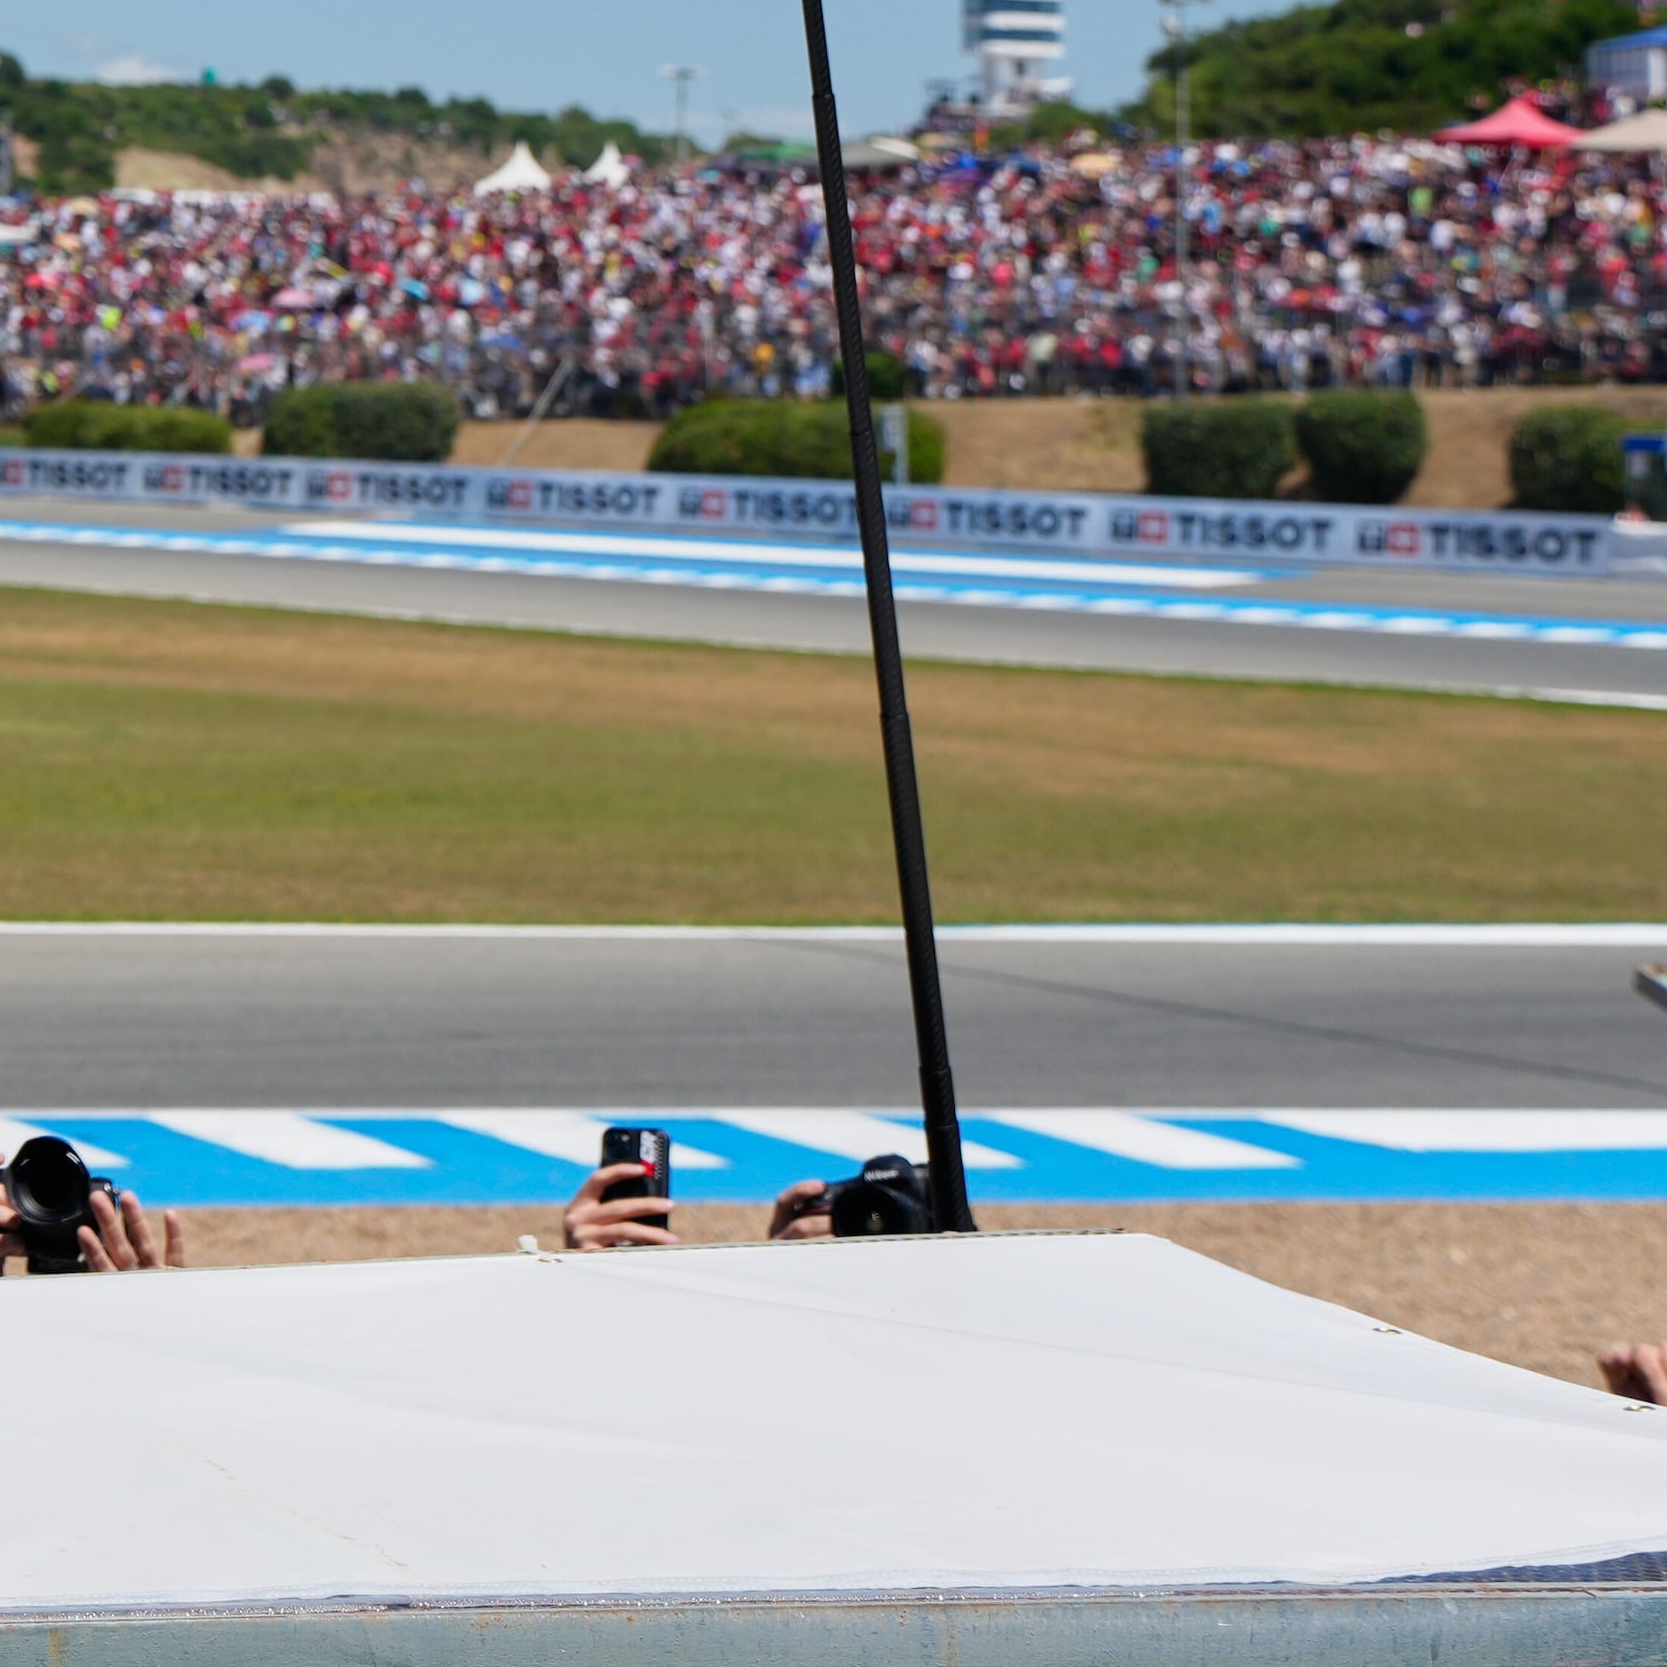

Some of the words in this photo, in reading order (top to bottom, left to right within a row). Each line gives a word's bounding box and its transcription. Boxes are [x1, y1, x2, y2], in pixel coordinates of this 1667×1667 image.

[358, 475, 468, 506] TISSOT
[539, 483, 660, 515] TISSOT
[947, 500, 1090, 537] TISSOT
[1177, 511, 1333, 550] TISSOT
[1431, 526, 1597, 566] TISSOT
